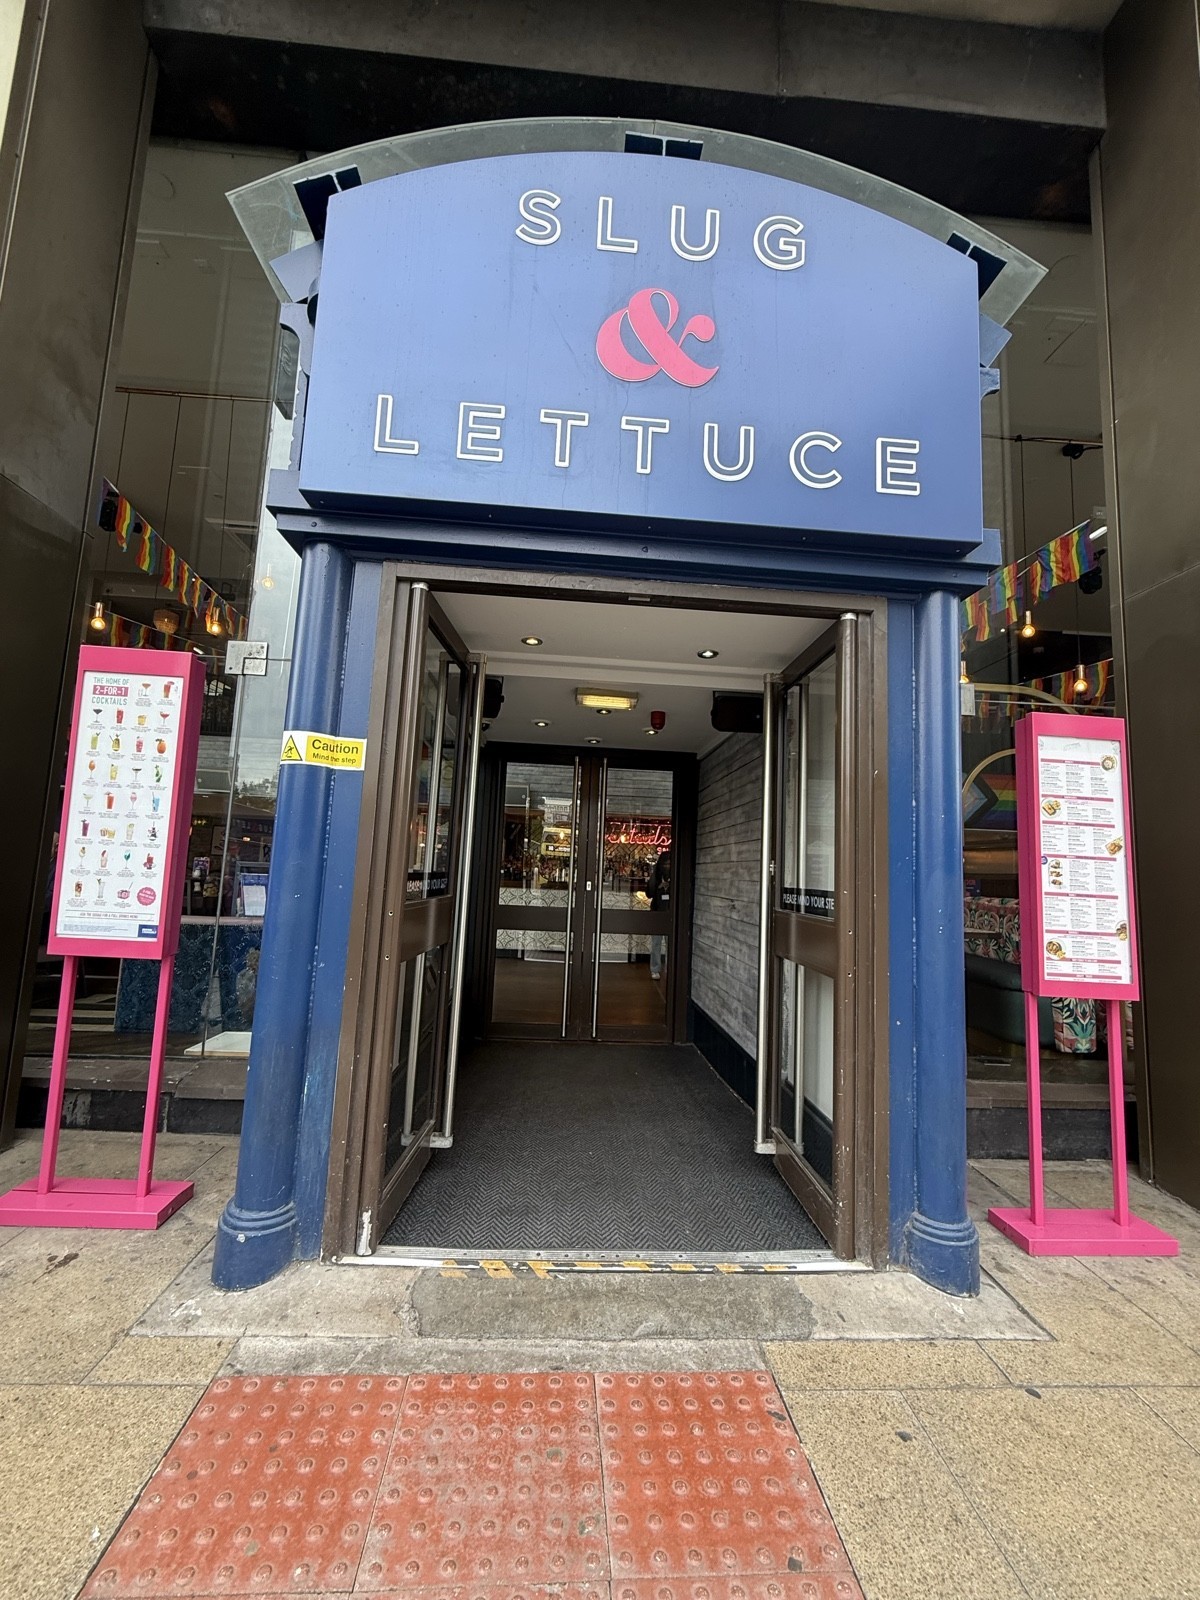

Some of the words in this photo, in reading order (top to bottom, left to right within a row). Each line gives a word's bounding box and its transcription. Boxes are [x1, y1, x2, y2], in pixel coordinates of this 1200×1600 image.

[515, 189, 806, 271] SLUG
[595, 287, 720, 388] &
[373, 394, 921, 497] LETTUCE
[93, 676, 104, 684] THE
[105, 677, 121, 685] HOME
[95, 686, 125, 696] 2-FOR-1
[91, 696, 128, 706] COCKTAILS
[311, 739, 359, 754] Caution
[312, 752, 329, 761] Mind
[341, 757, 356, 765] step
[783, 893, 797, 904] PLEASE
[798, 895, 810, 906] MIND
[811, 896, 825, 908] YOUR
[825, 897, 835, 910] STE
